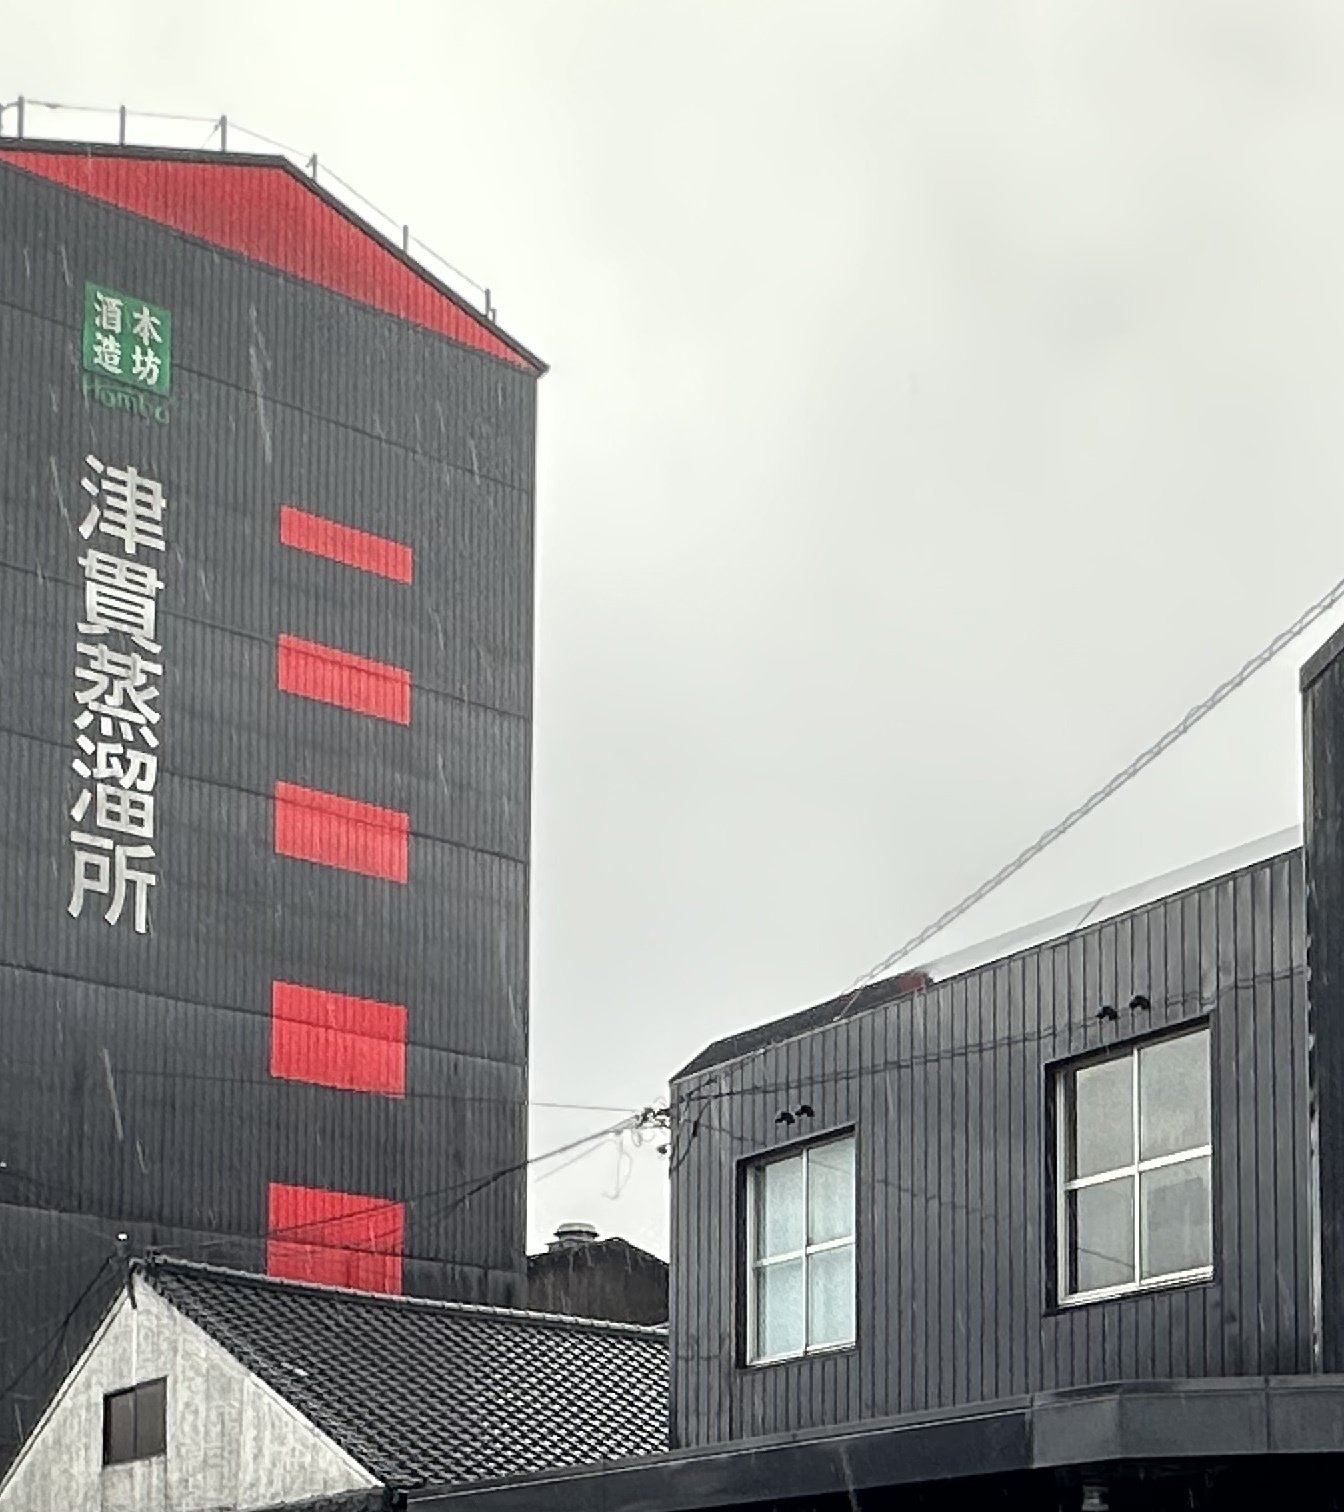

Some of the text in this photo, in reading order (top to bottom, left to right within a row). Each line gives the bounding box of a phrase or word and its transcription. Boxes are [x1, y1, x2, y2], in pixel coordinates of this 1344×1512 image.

[66, 453, 167, 935] 津貫蒸溜所
